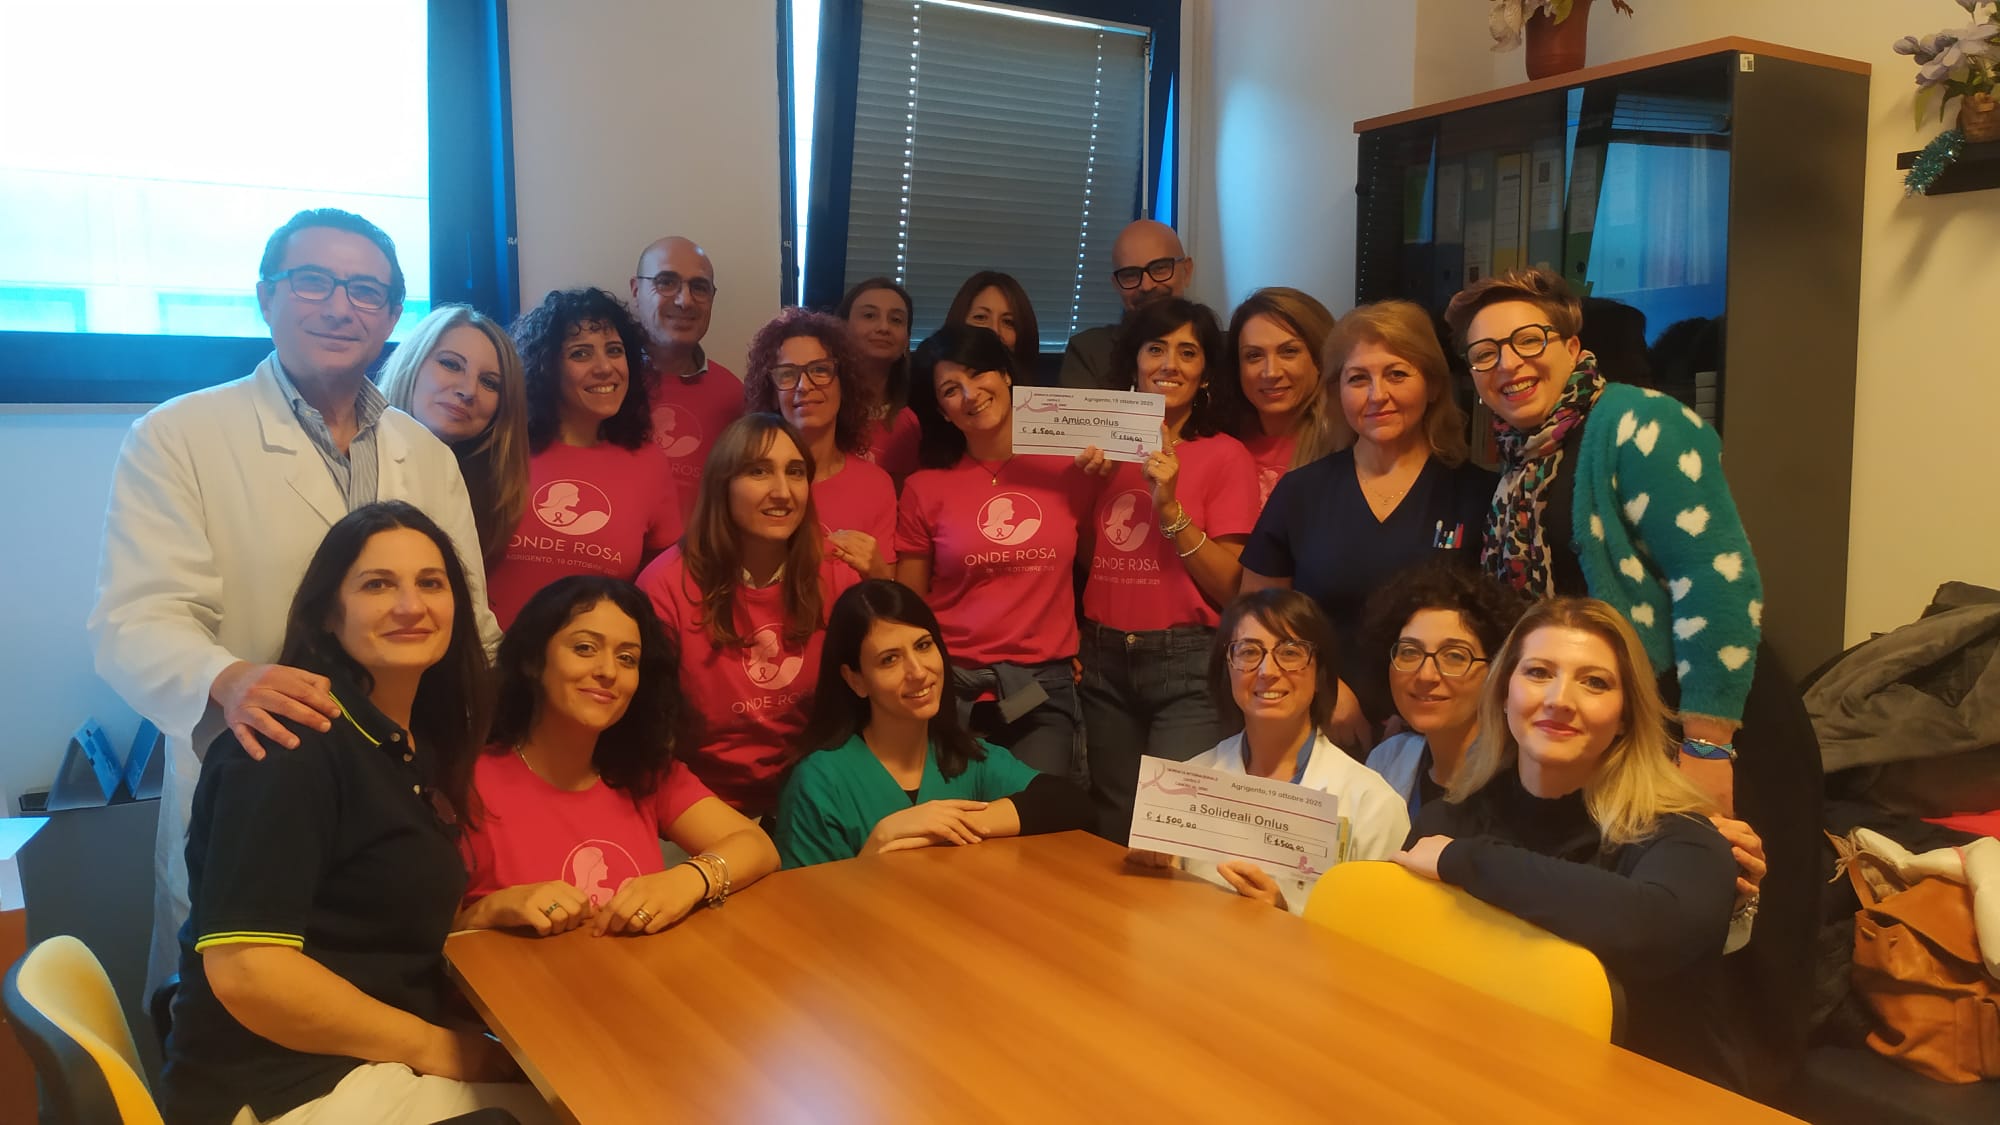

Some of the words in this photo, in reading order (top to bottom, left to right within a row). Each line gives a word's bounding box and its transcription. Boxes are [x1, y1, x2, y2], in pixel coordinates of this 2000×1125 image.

[1061, 415, 1091, 426] Amico
[1093, 418, 1119, 427] Onlus
[573, 542, 622, 563] ROSA
[964, 552, 1010, 567] ONDE
[1015, 548, 1057, 561] ROSA
[1094, 556, 1125, 571] ONDE
[1128, 558, 1160, 573] ROSA
[731, 696, 773, 714] ONDE
[1231, 782, 1268, 795] Agrigento,
[1277, 792, 1304, 803] ottobre
[1189, 804, 1197, 812] a
[1199, 804, 1251, 822] Solideali
[1254, 815, 1289, 832] Onlus
